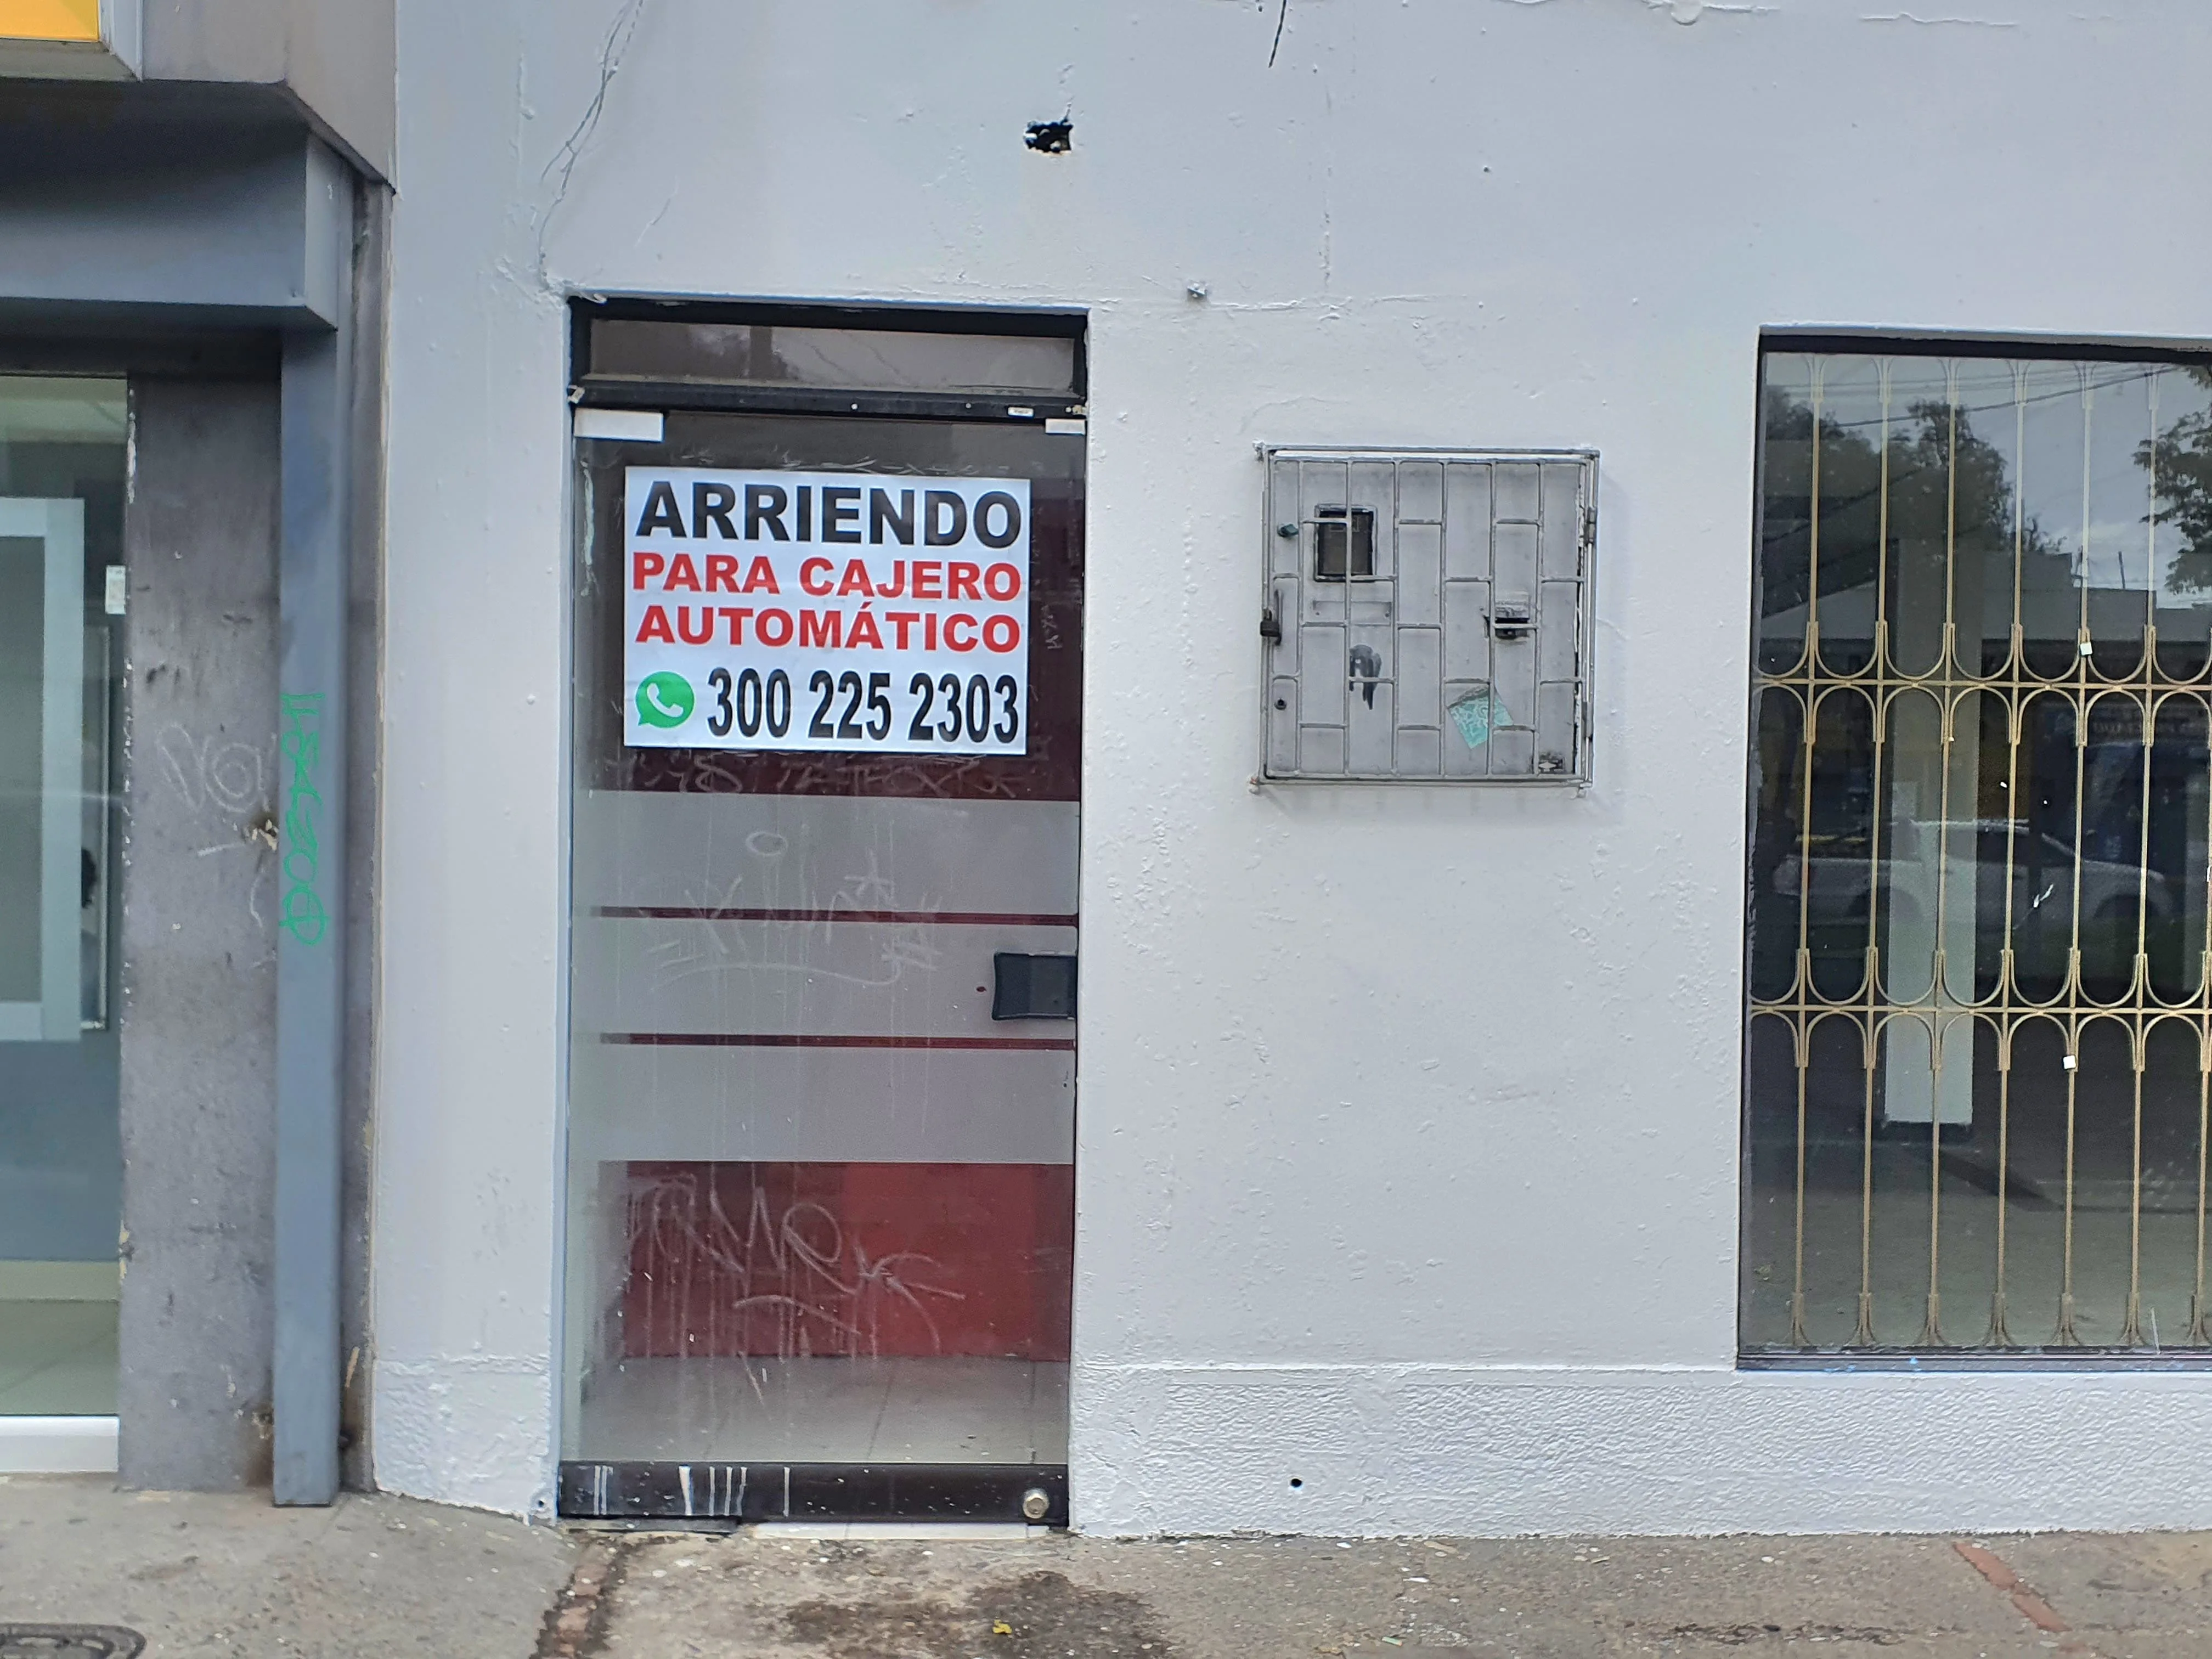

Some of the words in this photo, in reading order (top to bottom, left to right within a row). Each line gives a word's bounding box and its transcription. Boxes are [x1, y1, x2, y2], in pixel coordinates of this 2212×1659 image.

[635, 481, 1021, 548] ARRIENDO
[633, 552, 780, 594] PARA
[799, 557, 1021, 601] CAJERO
[635, 602, 1020, 653] AUTOMÁTICO
[707, 668, 791, 737] 300
[808, 670, 891, 740] 225
[909, 673, 1018, 743] 2303
